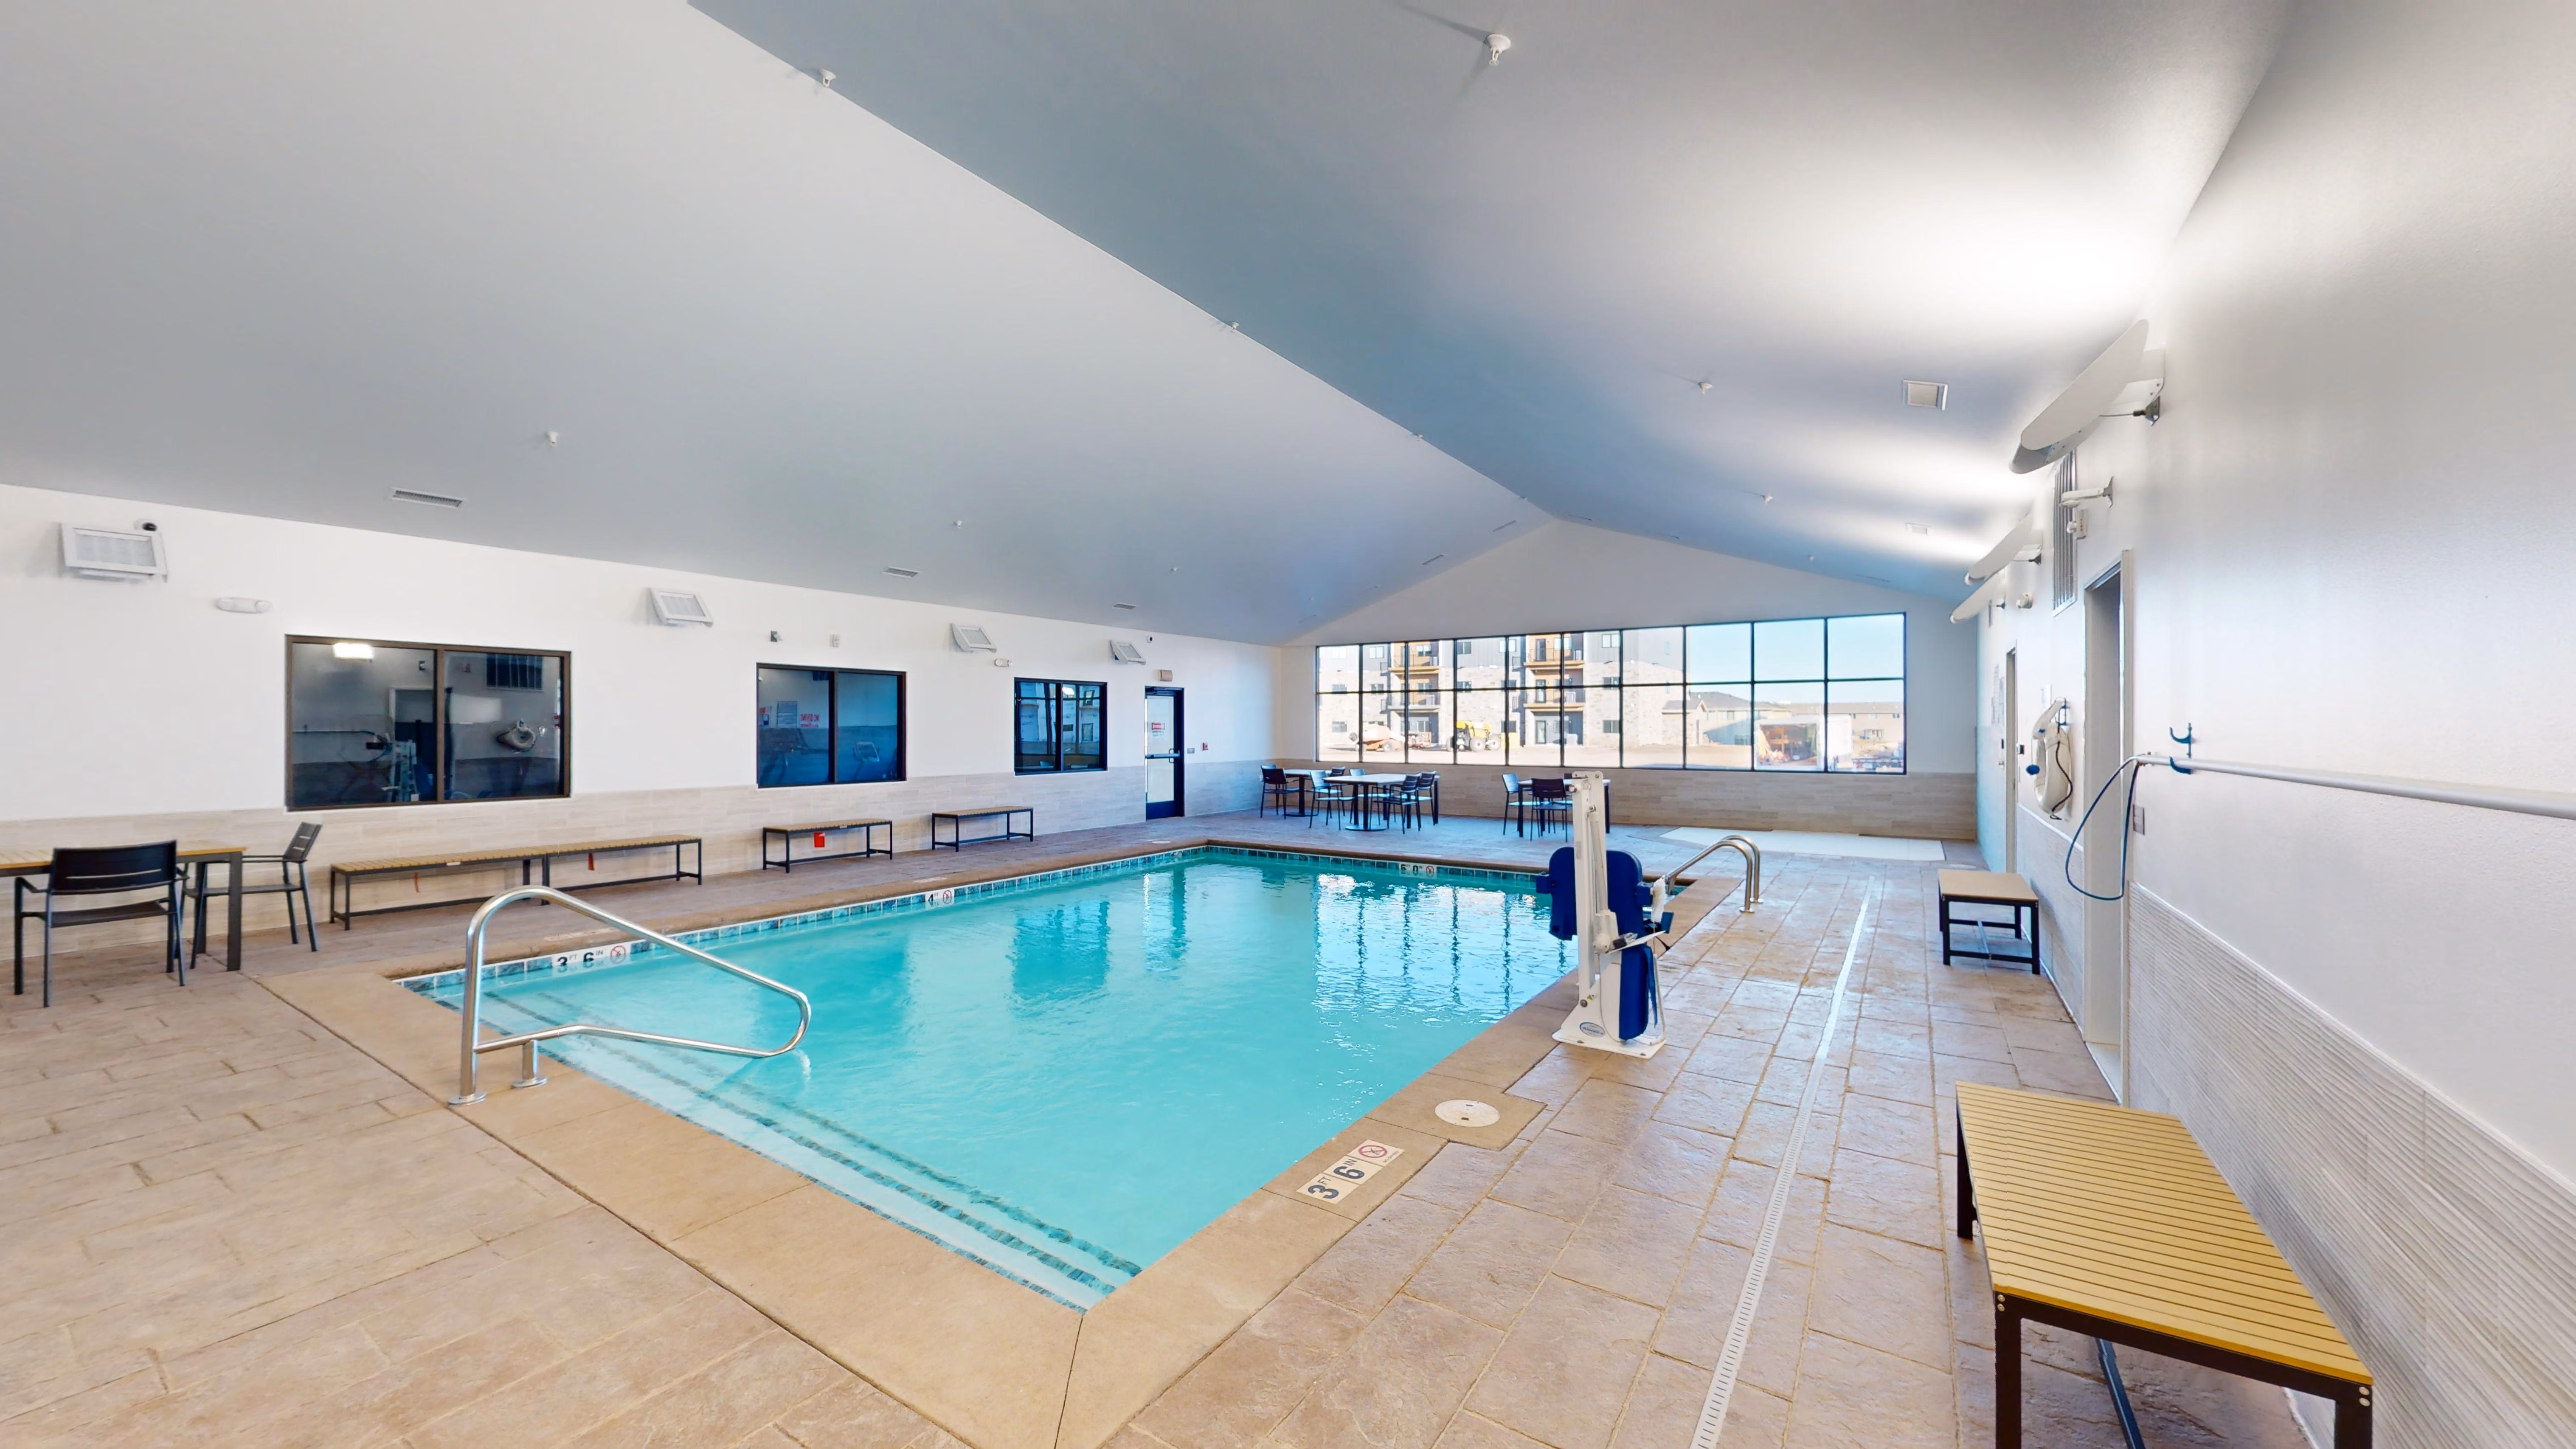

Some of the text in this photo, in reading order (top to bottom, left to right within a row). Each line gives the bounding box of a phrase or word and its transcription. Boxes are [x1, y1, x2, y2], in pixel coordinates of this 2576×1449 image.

[558, 957, 568, 966] 3
[583, 952, 594, 962] 6
[1333, 1166, 1364, 1179] 6
[1318, 1177, 1331, 1185] FT
[1308, 1185, 1339, 1199] 3
